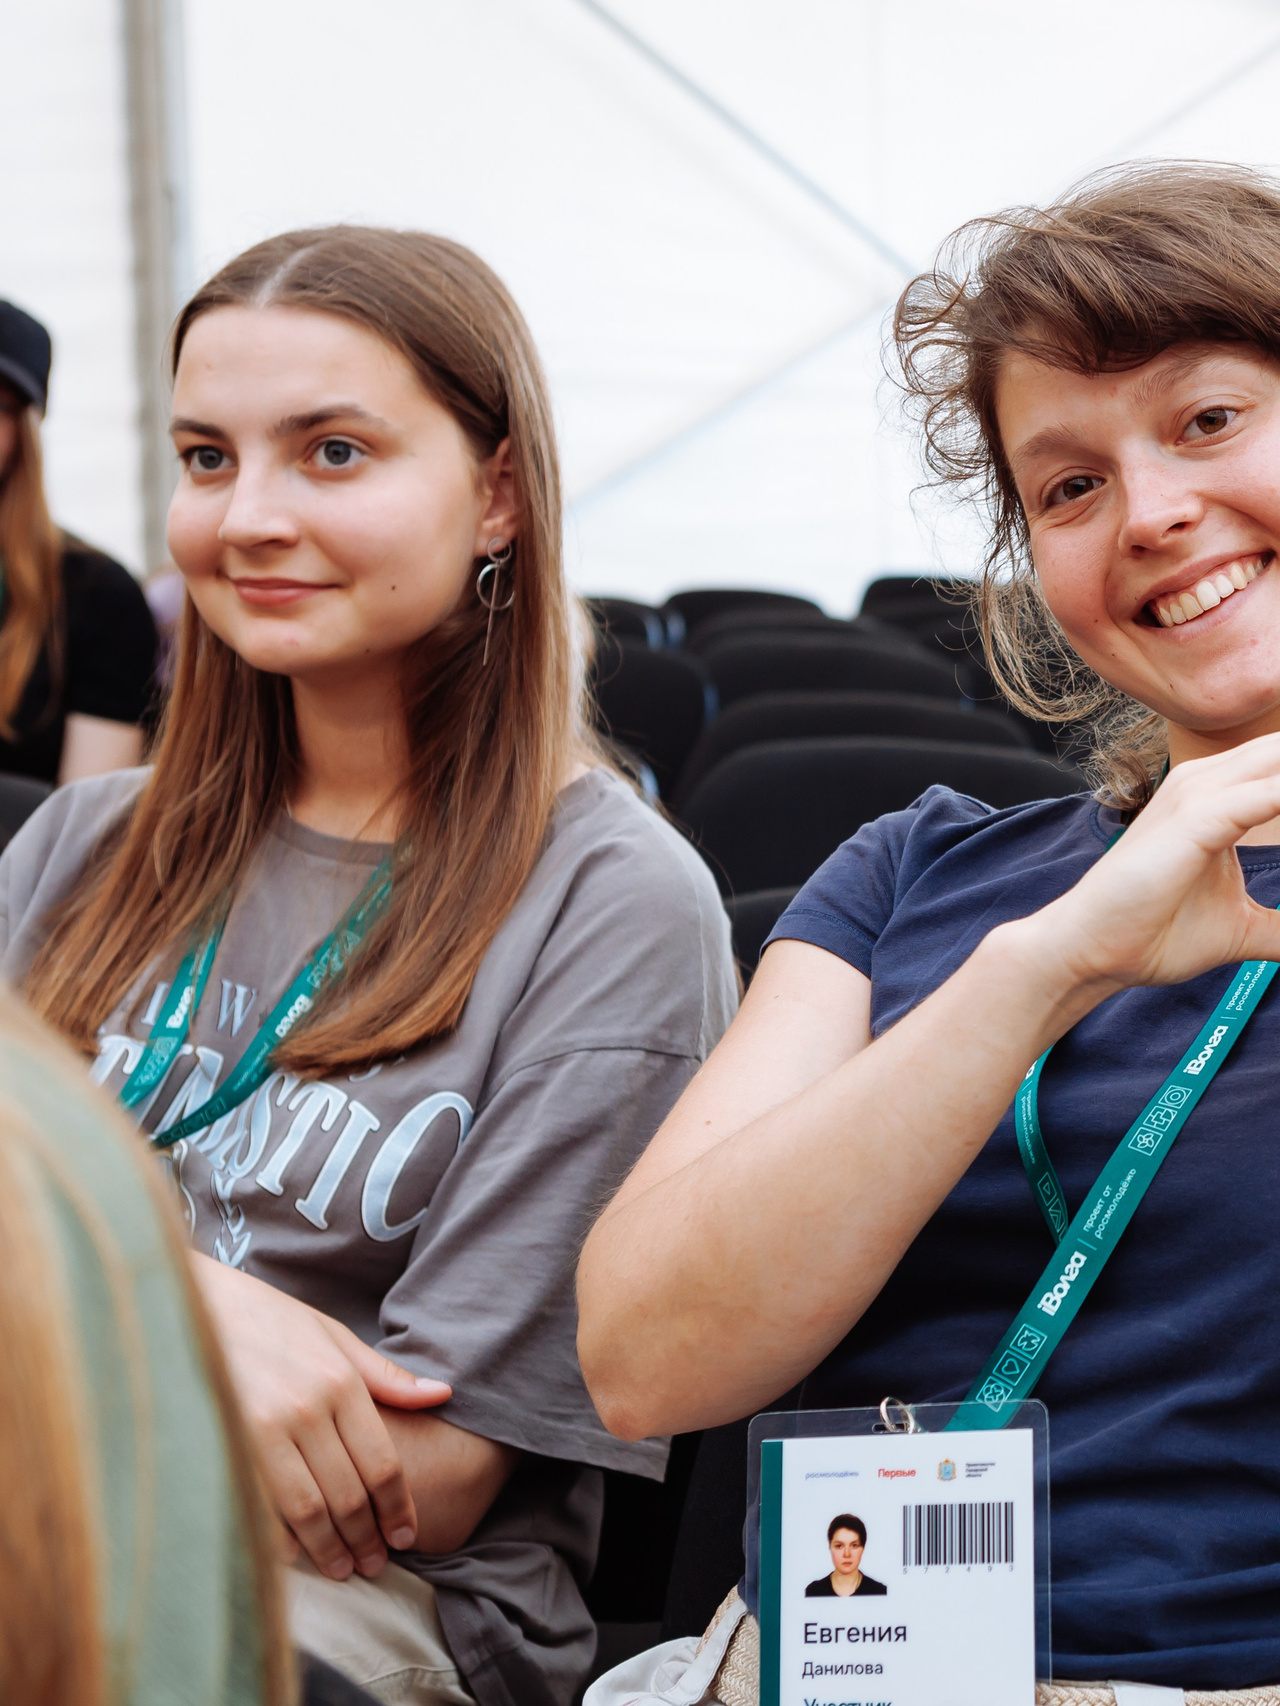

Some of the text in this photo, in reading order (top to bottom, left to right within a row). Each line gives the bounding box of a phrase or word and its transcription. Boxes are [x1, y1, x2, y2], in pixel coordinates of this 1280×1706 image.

[1225, 971, 1252, 1011] проект от
[1083, 1185, 1113, 1232] проект от
[877, 1467, 916, 1480] Первые
[803, 1621, 908, 1644] Евгения
[801, 1660, 884, 1680] Данилова
